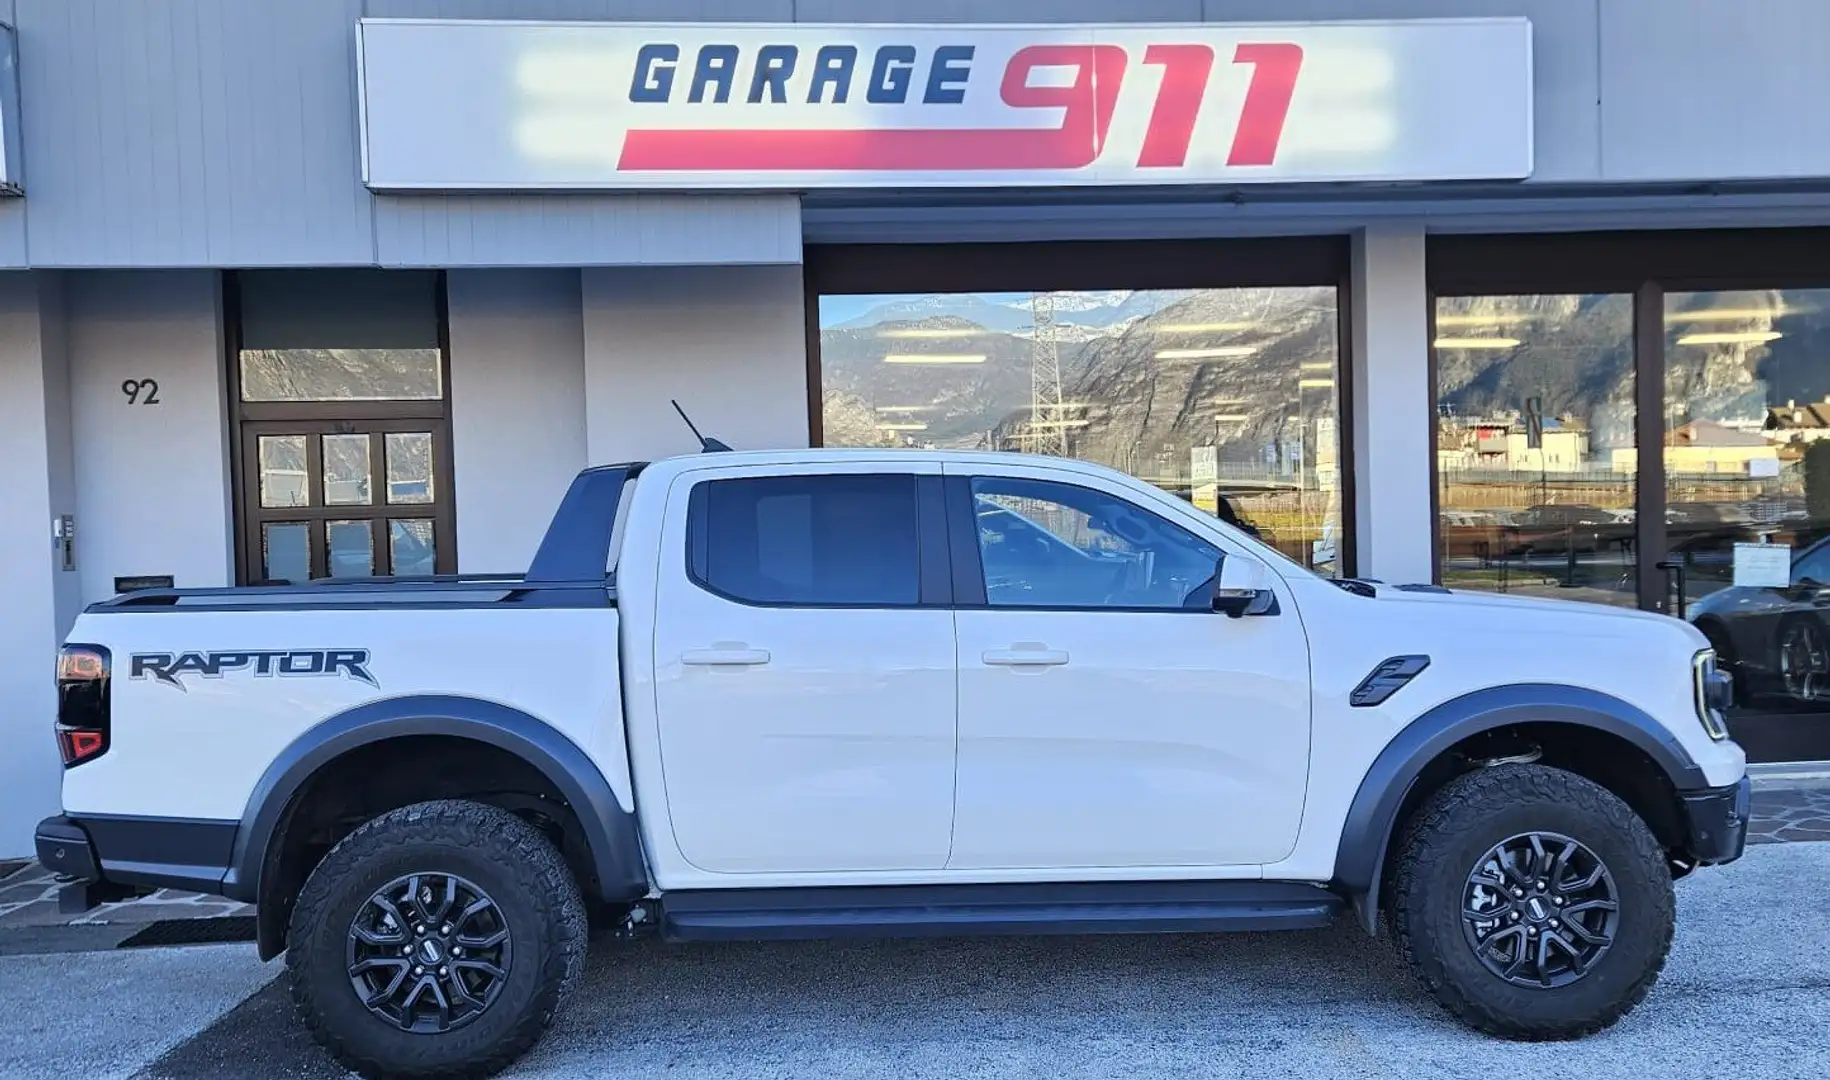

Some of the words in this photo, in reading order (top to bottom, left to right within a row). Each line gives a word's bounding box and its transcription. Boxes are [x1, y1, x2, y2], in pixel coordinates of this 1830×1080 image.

[628, 44, 976, 104] GARAGE
[999, 43, 1304, 170] 911
[122, 379, 160, 405] 92
[129, 648, 380, 692] RAPTOR
